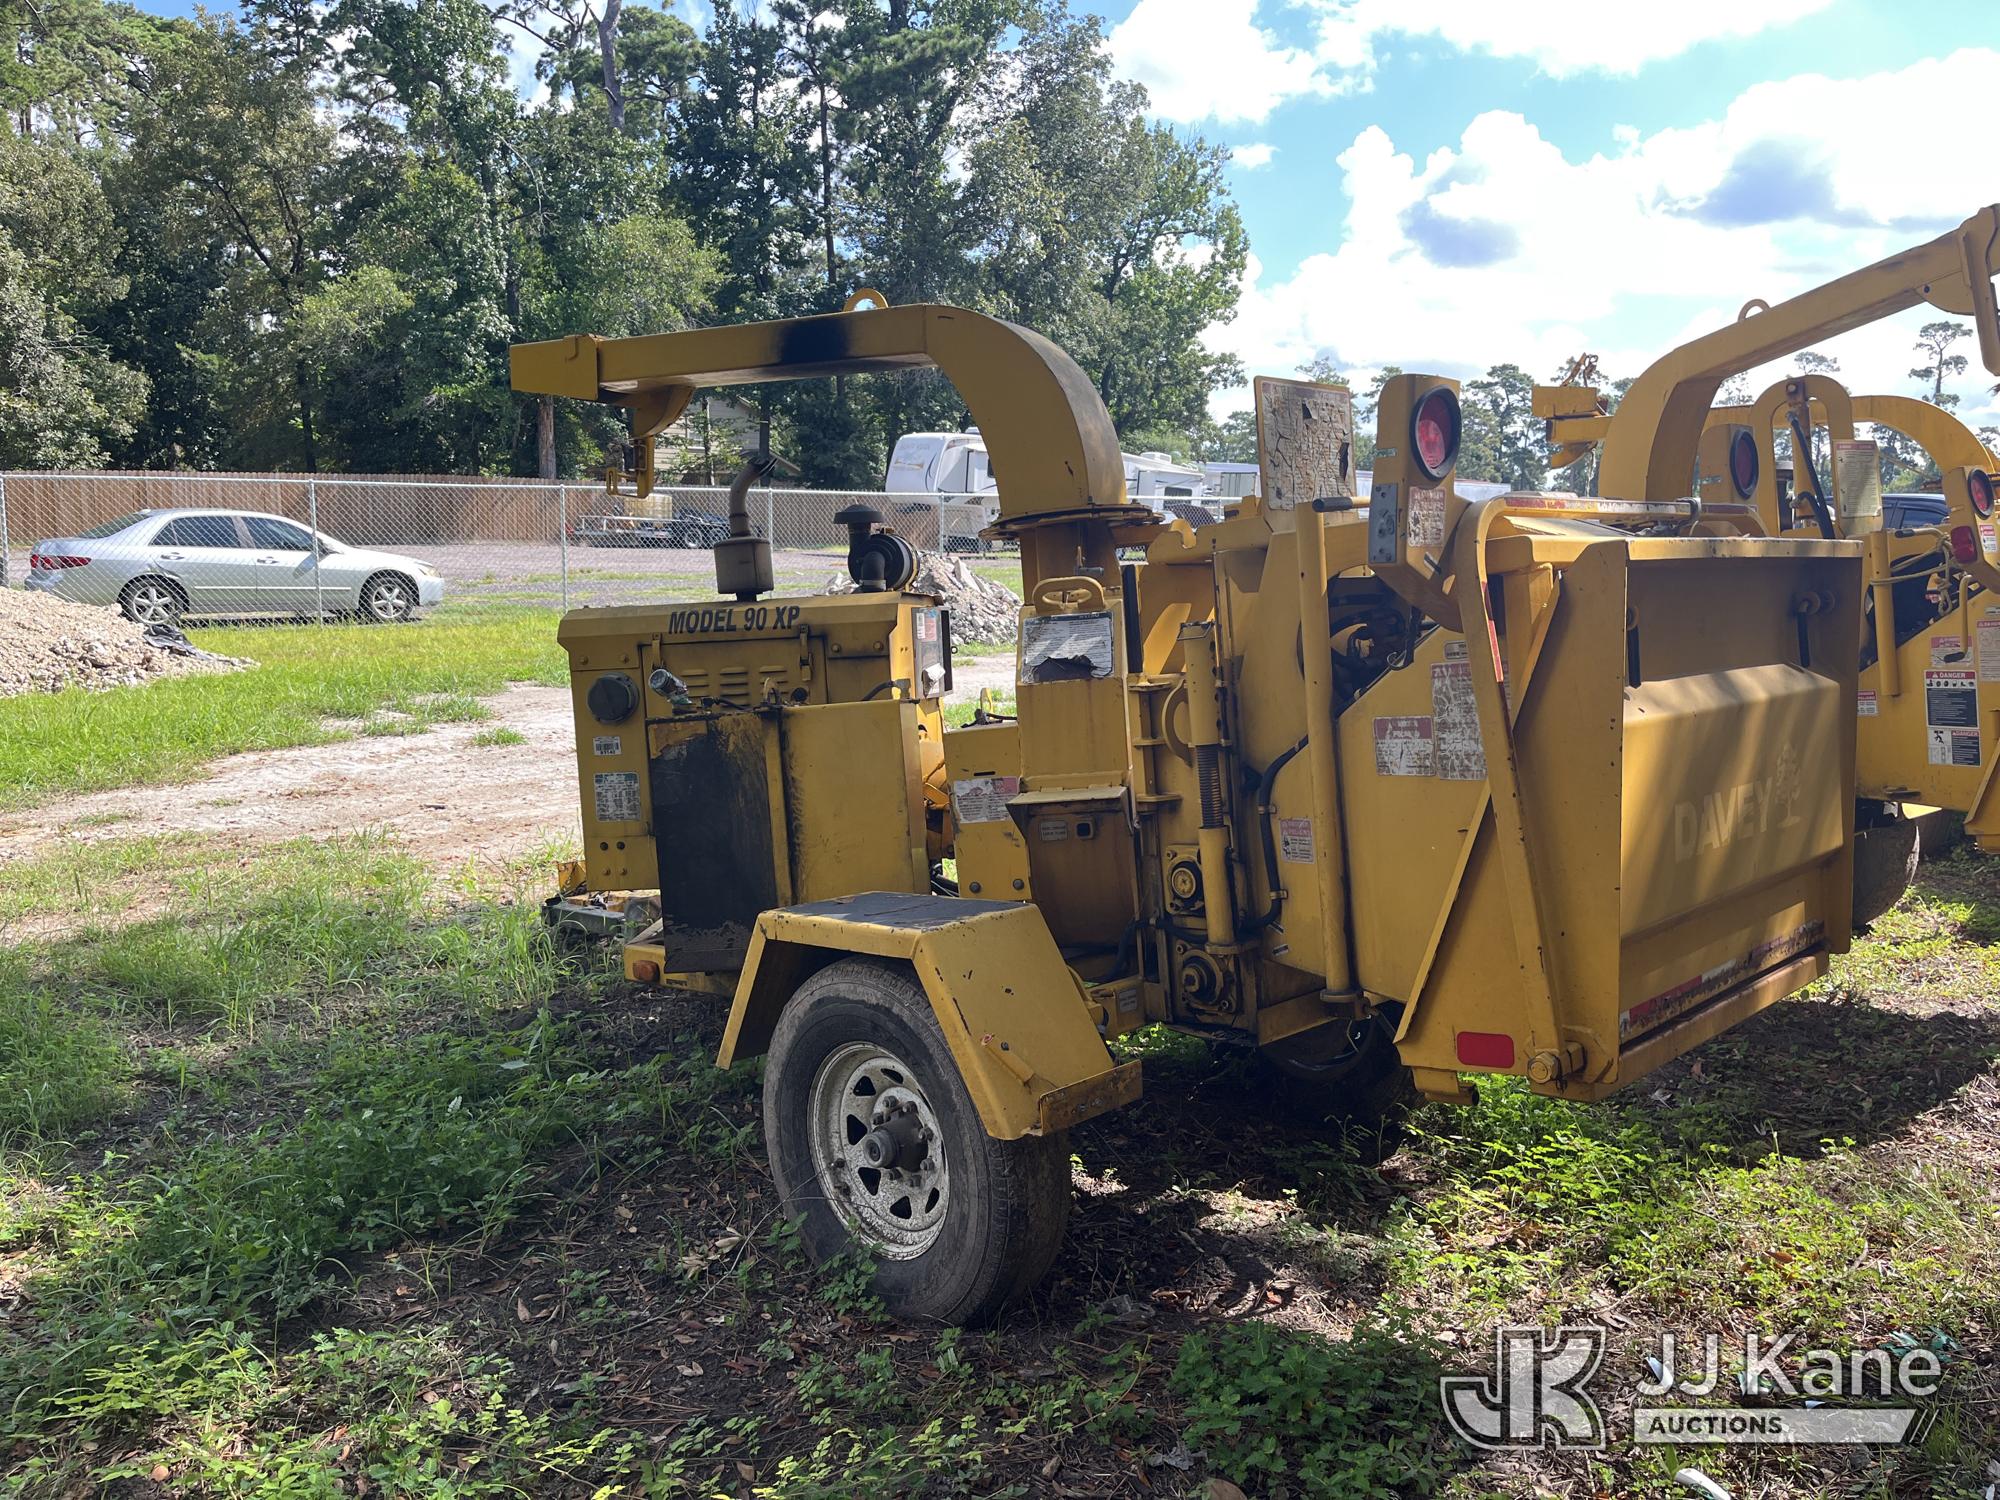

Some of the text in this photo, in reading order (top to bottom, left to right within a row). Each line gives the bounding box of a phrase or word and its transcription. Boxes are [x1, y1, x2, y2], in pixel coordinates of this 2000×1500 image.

[668, 605, 800, 634] MODEL 90 XP
[1674, 776, 1773, 864] DAVEY
